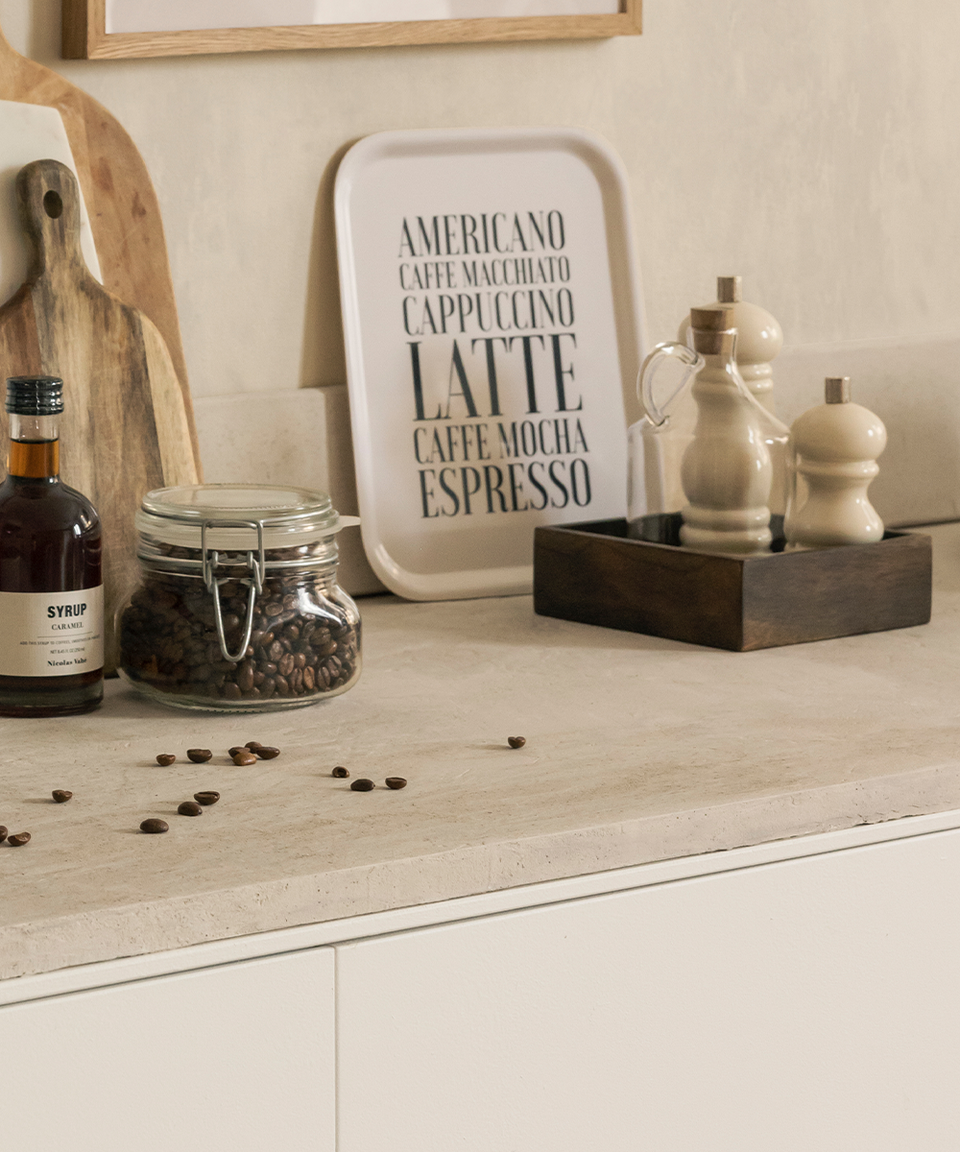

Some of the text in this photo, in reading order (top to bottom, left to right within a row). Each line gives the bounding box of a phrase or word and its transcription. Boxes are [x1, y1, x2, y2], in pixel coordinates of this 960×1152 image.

[397, 209, 566, 258] AMERICANO
[398, 256, 571, 291] CAFFE MACCHIATO
[402, 287, 575, 336] CAPPUCCINO
[405, 333, 583, 422] LATTE
[413, 417, 590, 465] CAFFE MOCHA
[418, 458, 592, 519] ESPRESSO
[47, 603, 87, 619] SYRUP
[51, 621, 84, 631] CARAMEL
[47, 659, 73, 667] Nicolas
